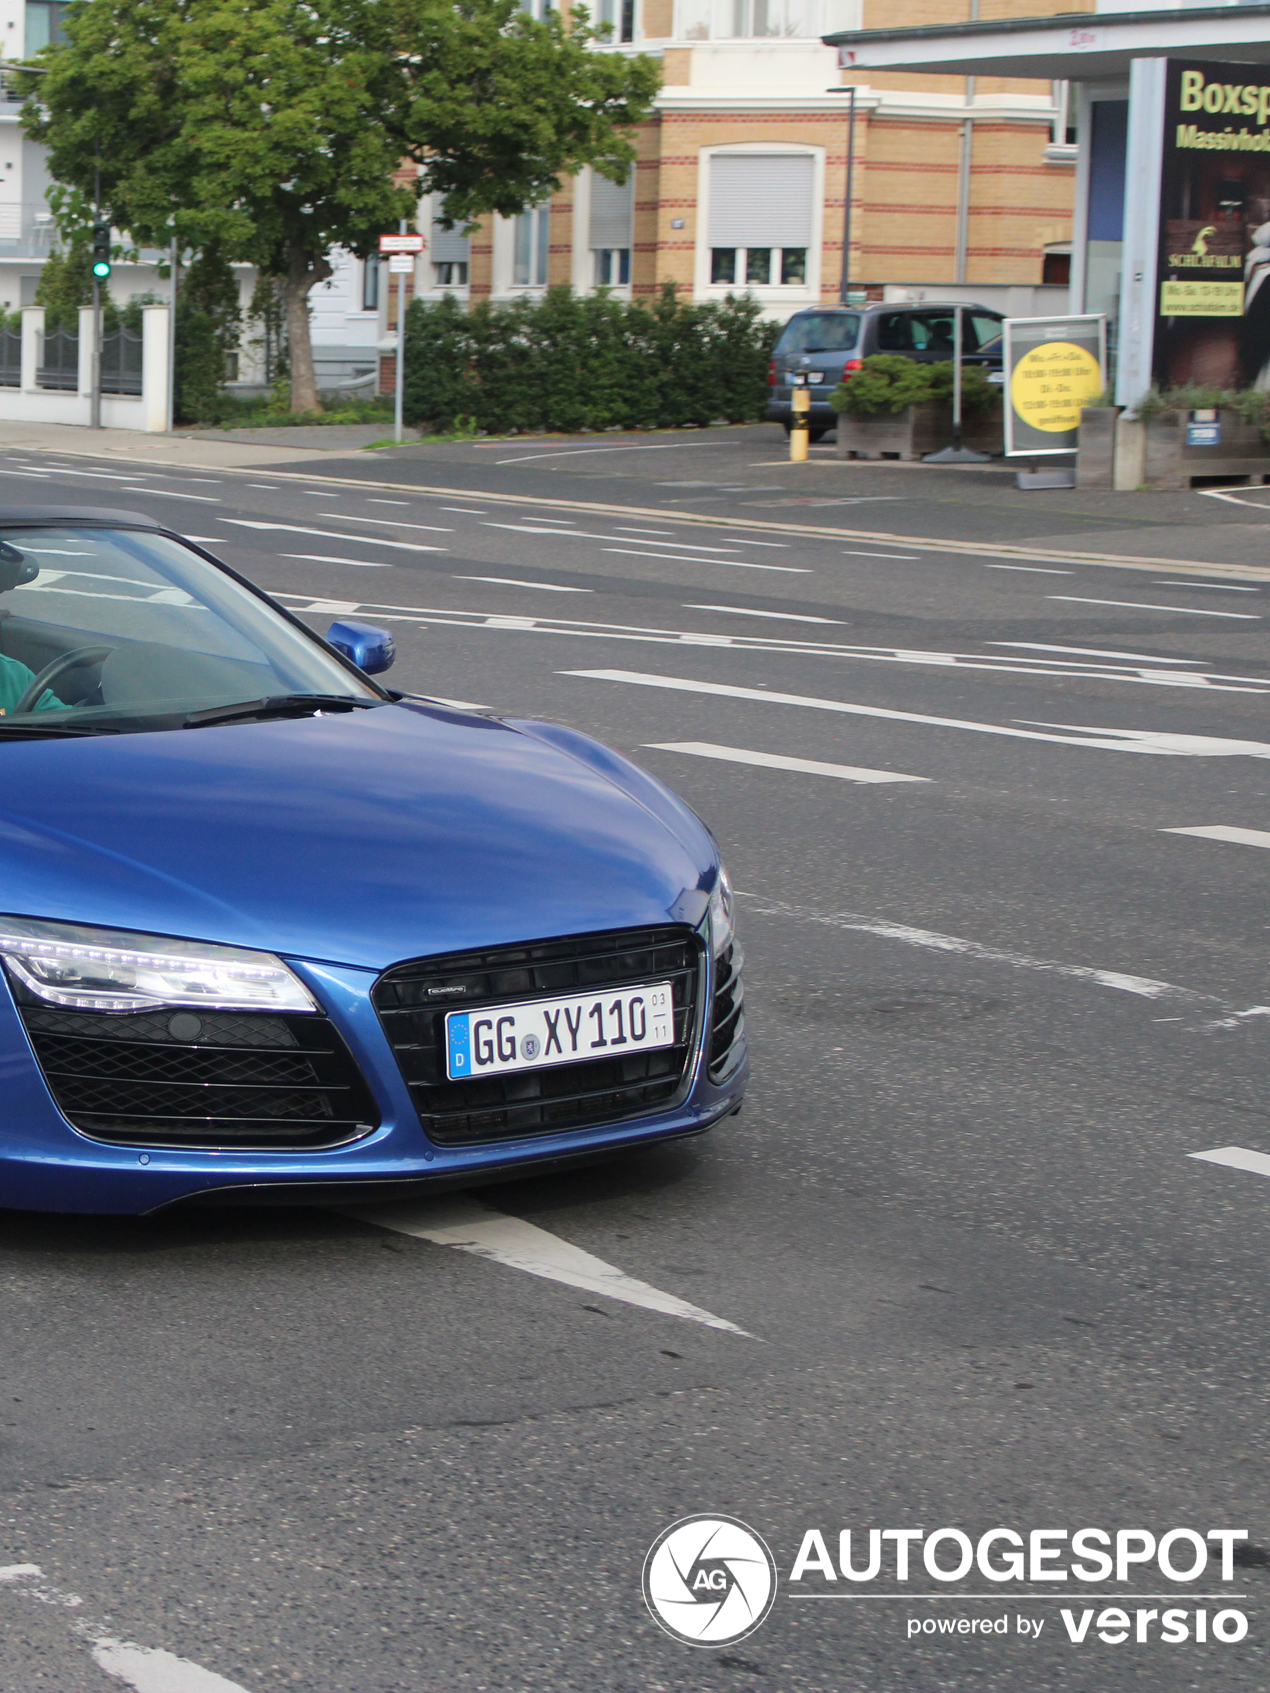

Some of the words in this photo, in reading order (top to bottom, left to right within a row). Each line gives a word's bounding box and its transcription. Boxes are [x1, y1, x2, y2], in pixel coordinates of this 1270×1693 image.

[1176, 124, 1270, 152] Massivhol
[473, 1016, 517, 1066] GG
[455, 1052, 465, 1068] D
